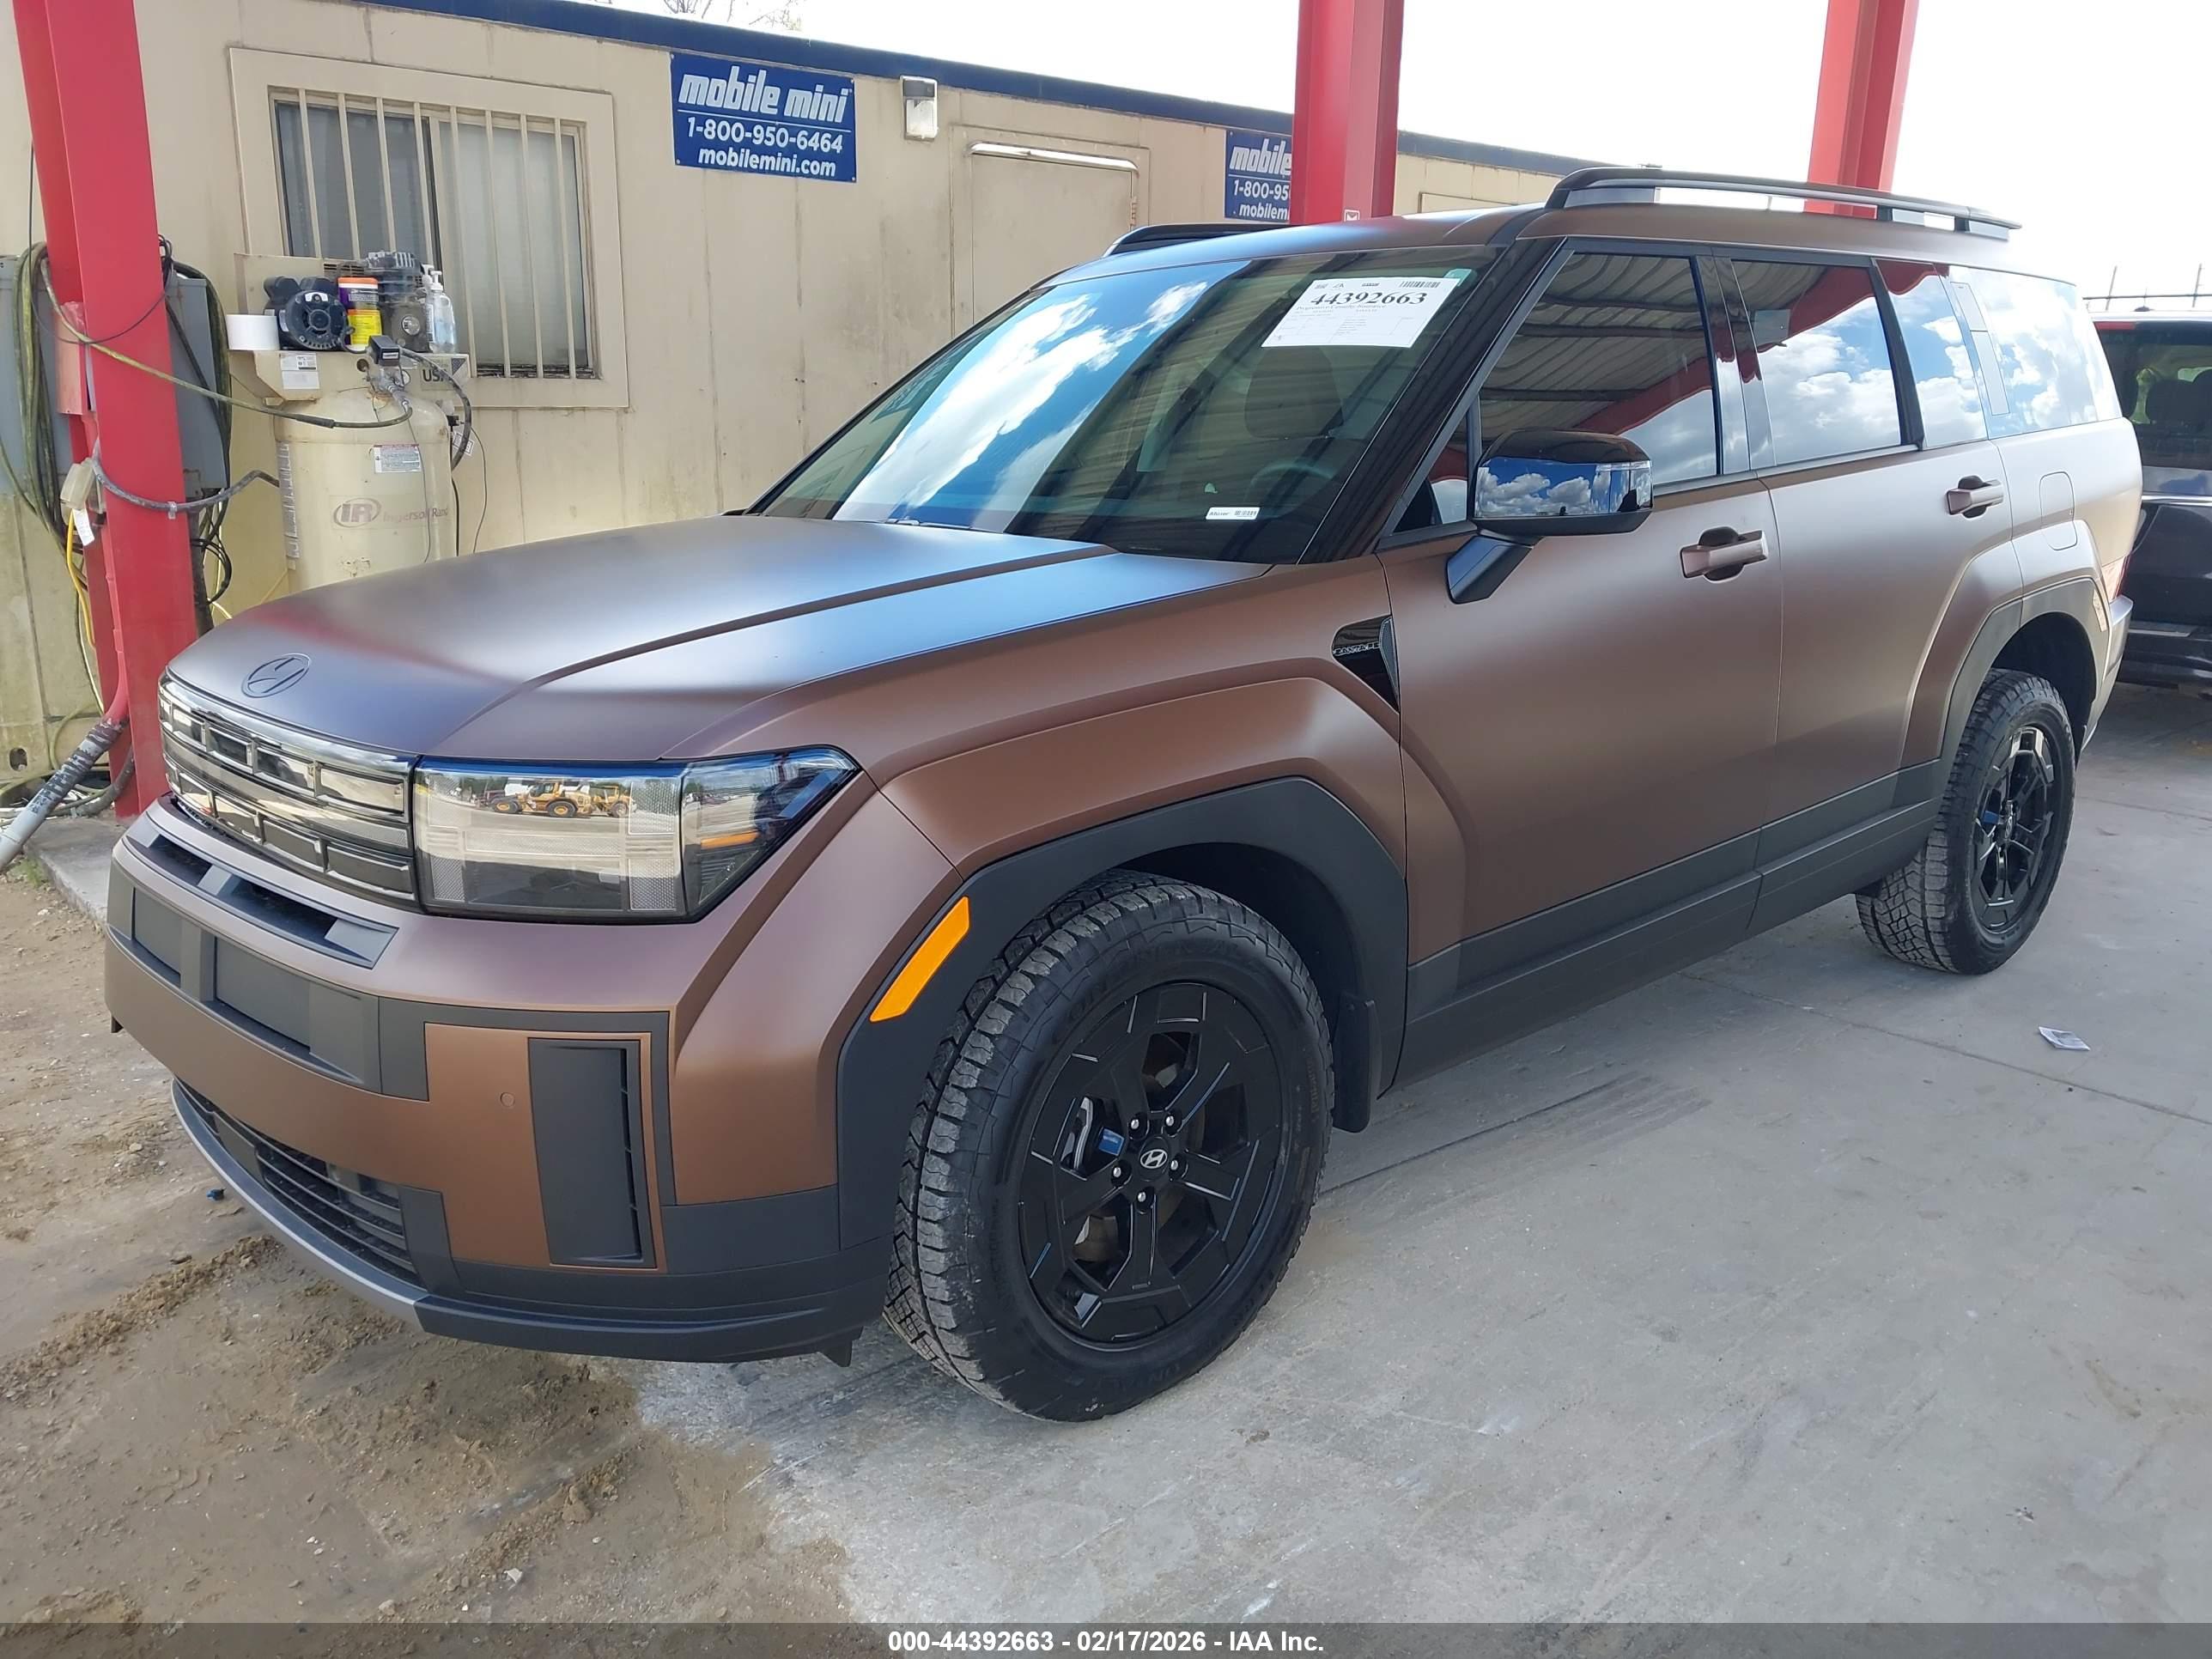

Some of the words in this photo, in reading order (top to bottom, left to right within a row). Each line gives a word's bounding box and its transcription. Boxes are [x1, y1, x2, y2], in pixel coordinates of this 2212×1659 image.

[678, 66, 781, 115] mobile
[783, 84, 850, 123] mini
[687, 117, 843, 154] 1-800-950-6464
[698, 147, 836, 177] mobilemini.com
[1230, 138, 1291, 175] mobile
[1233, 179, 1291, 201] 1-800-95
[1310, 292, 1427, 305] 44392663
